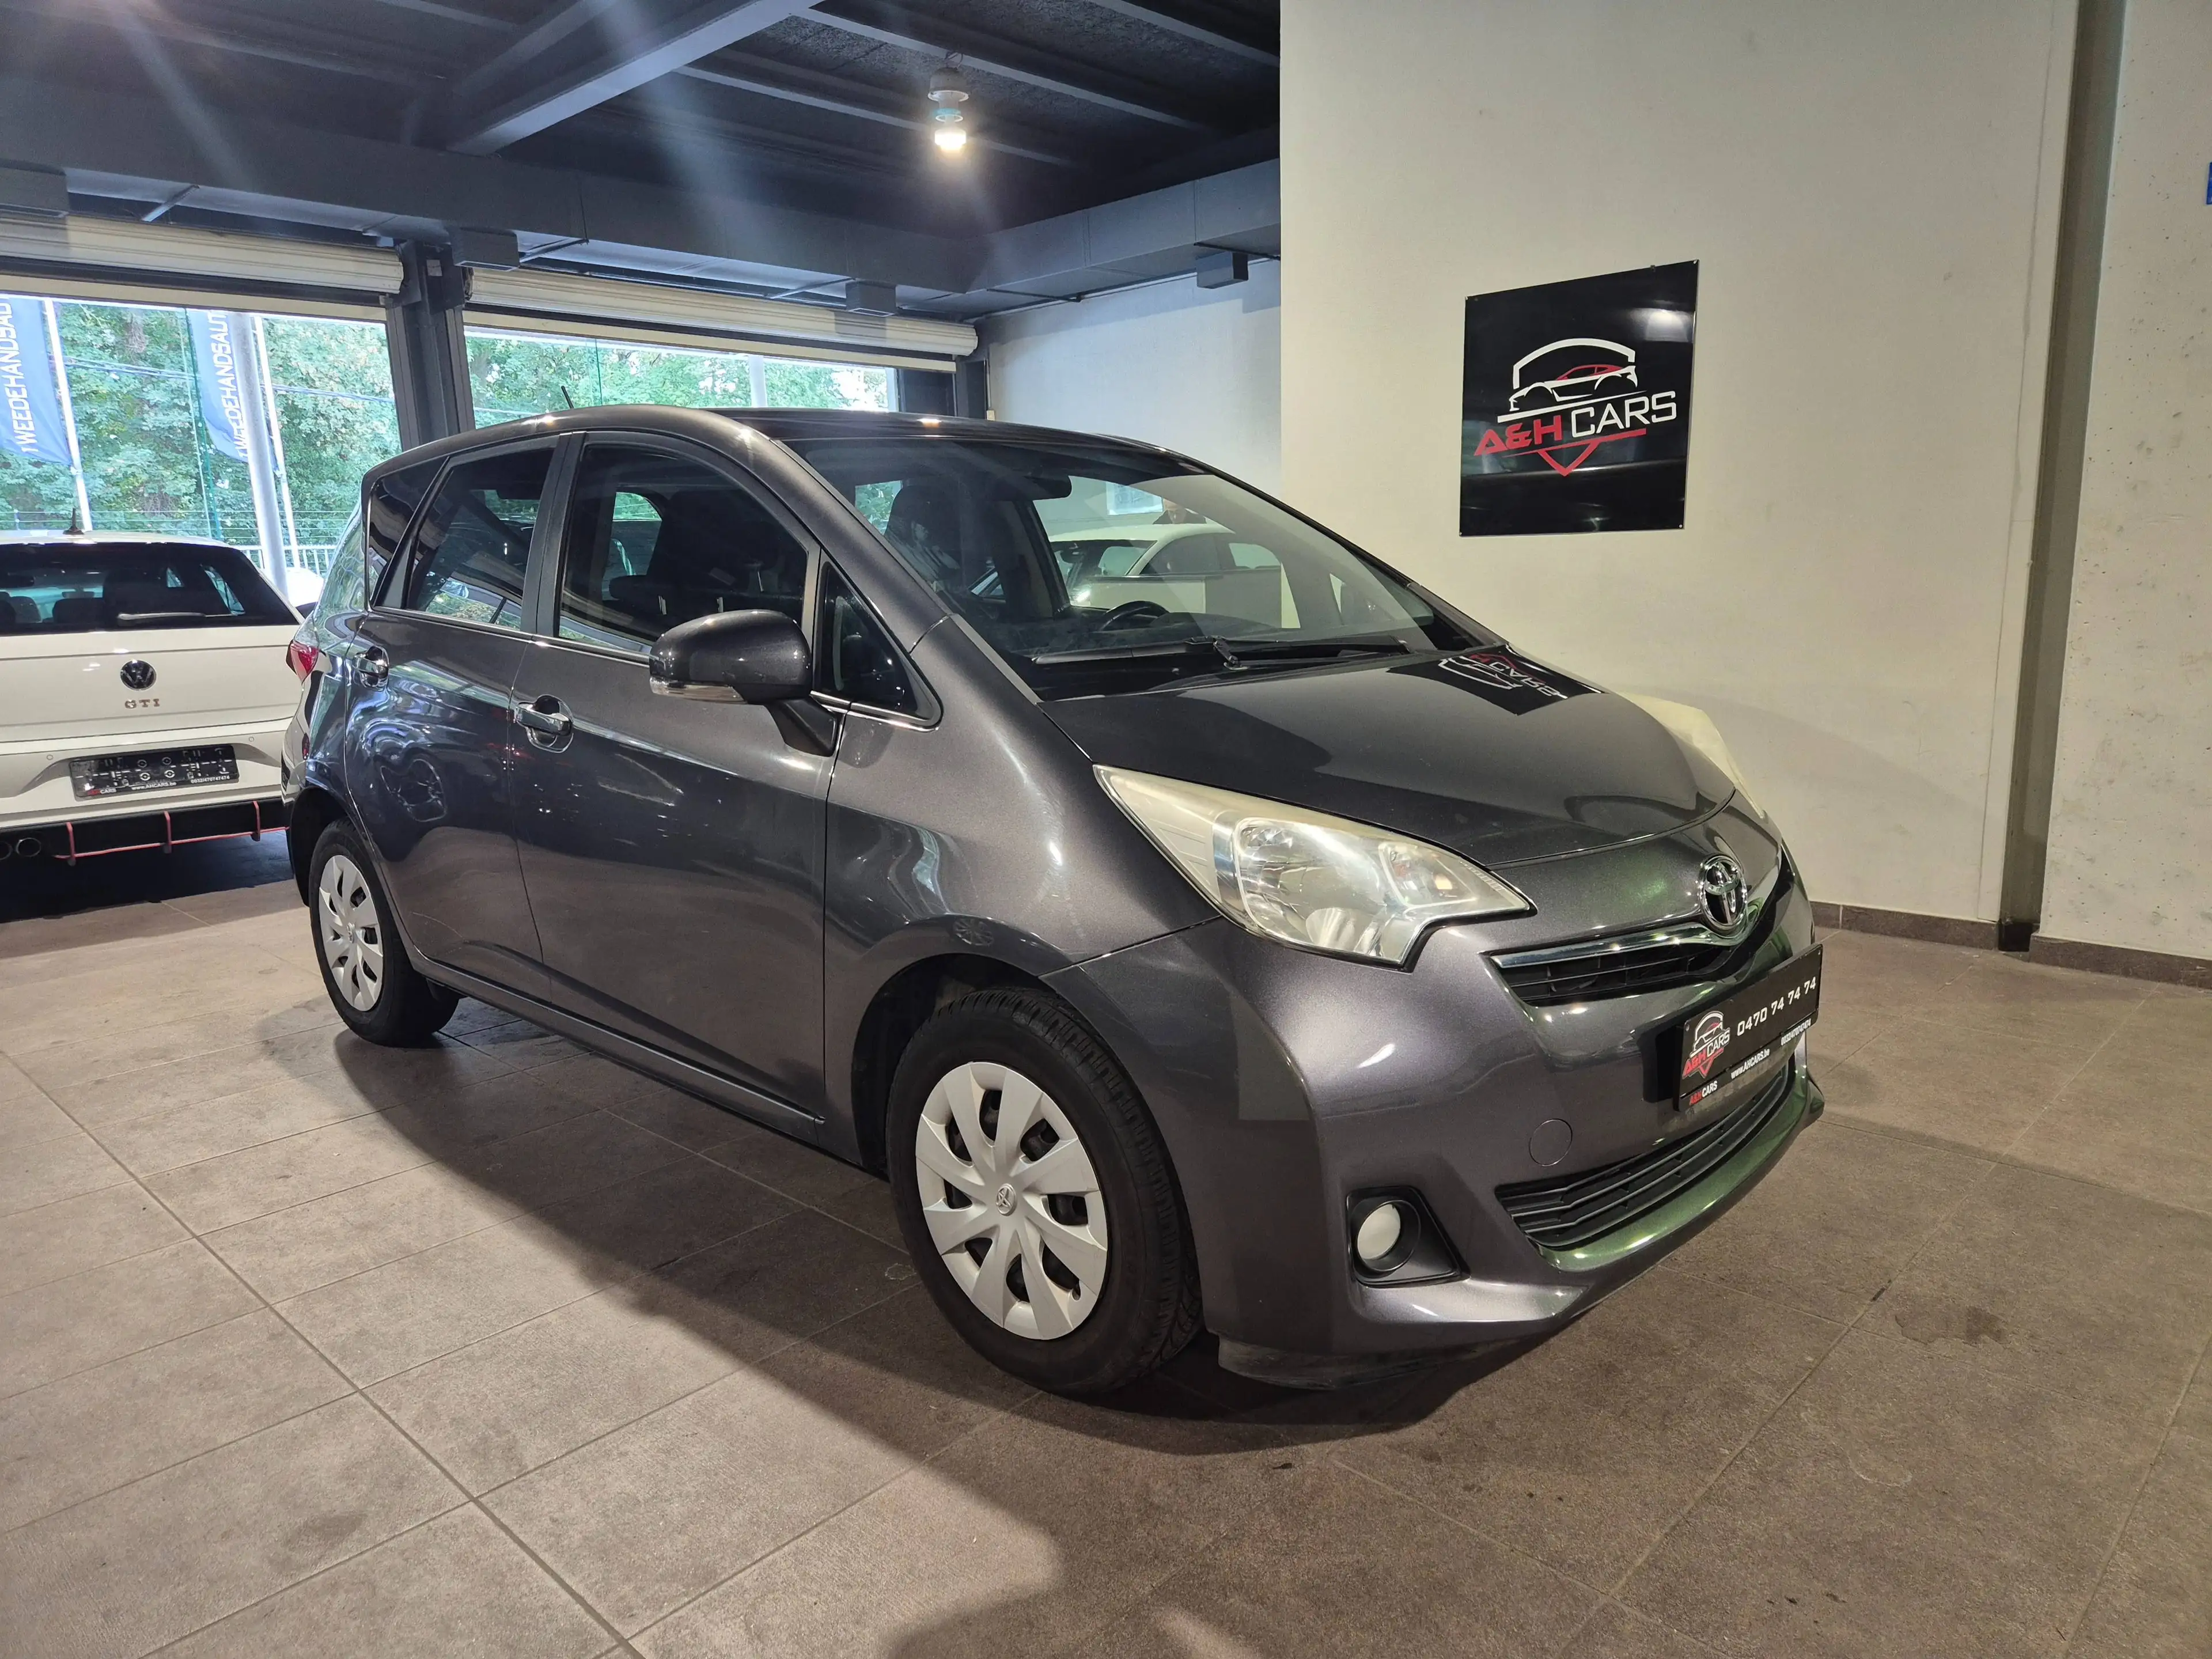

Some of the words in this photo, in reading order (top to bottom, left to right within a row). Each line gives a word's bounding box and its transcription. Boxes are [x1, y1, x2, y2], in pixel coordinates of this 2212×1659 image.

[0, 297, 39, 452] TWEEDEHANDSAU
[1474, 415, 1562, 456] A&H
[1571, 391, 1677, 438] CARS
[125, 698, 160, 709] GTI
[131, 782, 177, 790] www.AHCARS.be
[1737, 1007, 1767, 1036] 0470
[1771, 997, 1784, 1015] 74
[1788, 986, 1801, 1005] 74
[1804, 976, 1816, 994] 74
[1707, 1031, 1730, 1058] CARS
[1730, 1048, 1770, 1079] www.AHCARS.be
[1702, 1080, 1718, 1097] CARS
